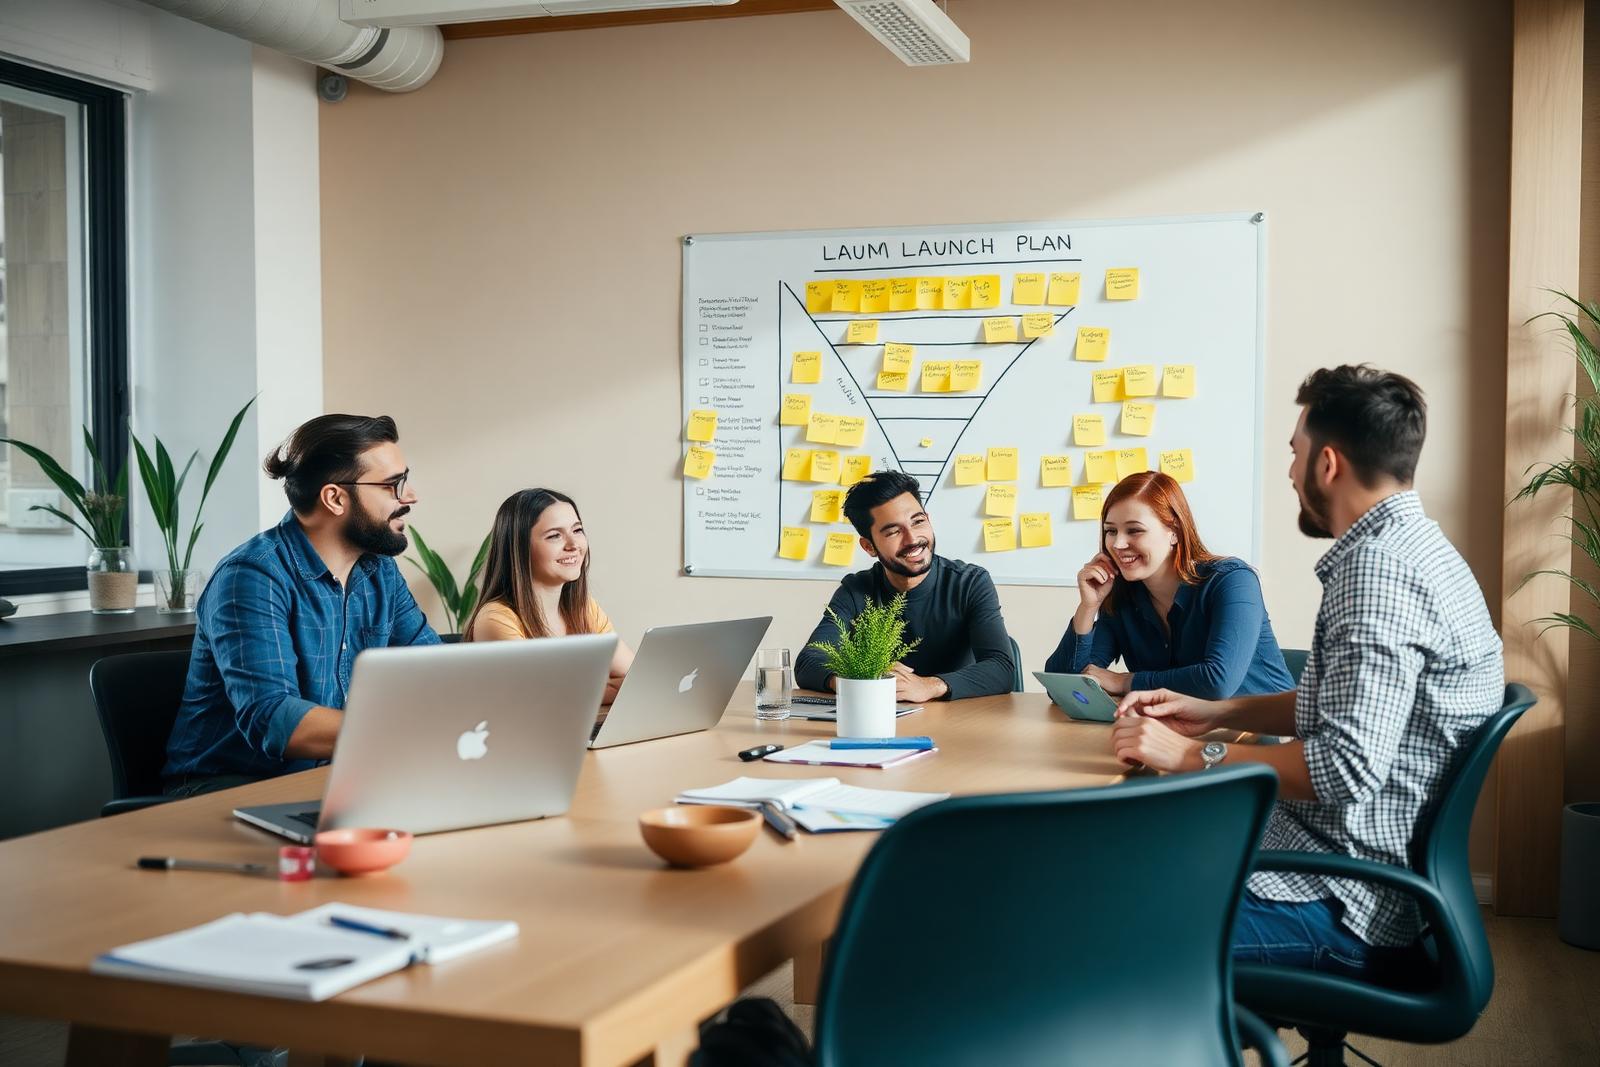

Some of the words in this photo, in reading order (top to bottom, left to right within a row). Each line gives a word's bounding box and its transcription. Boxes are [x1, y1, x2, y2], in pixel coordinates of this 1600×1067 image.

[824, 242, 888, 260] LAUM
[903, 238, 993, 257] LAUNCH
[1017, 235, 1071, 252] PLAN
